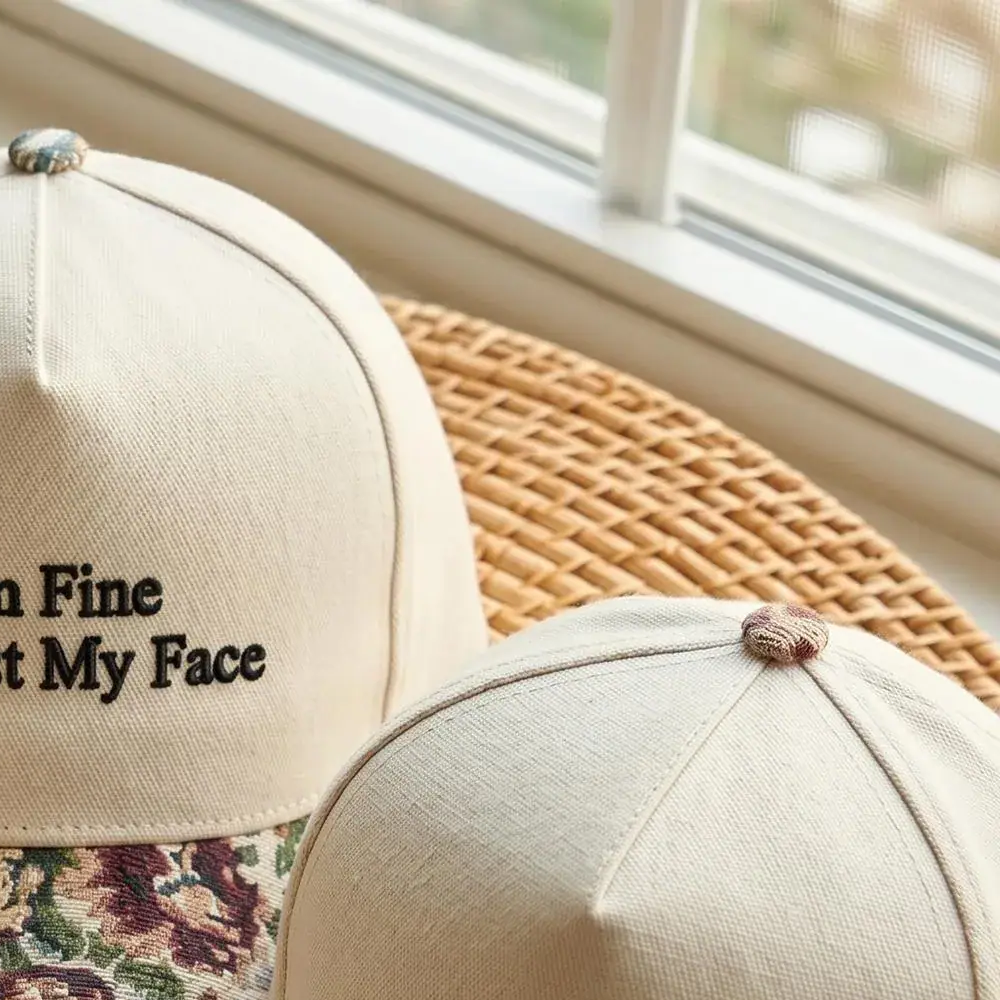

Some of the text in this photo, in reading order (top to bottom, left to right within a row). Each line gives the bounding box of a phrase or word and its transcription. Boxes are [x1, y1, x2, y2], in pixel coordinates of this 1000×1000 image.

[39, 563, 163, 617] Fine
[39, 635, 136, 703] My
[150, 633, 267, 689] Face
